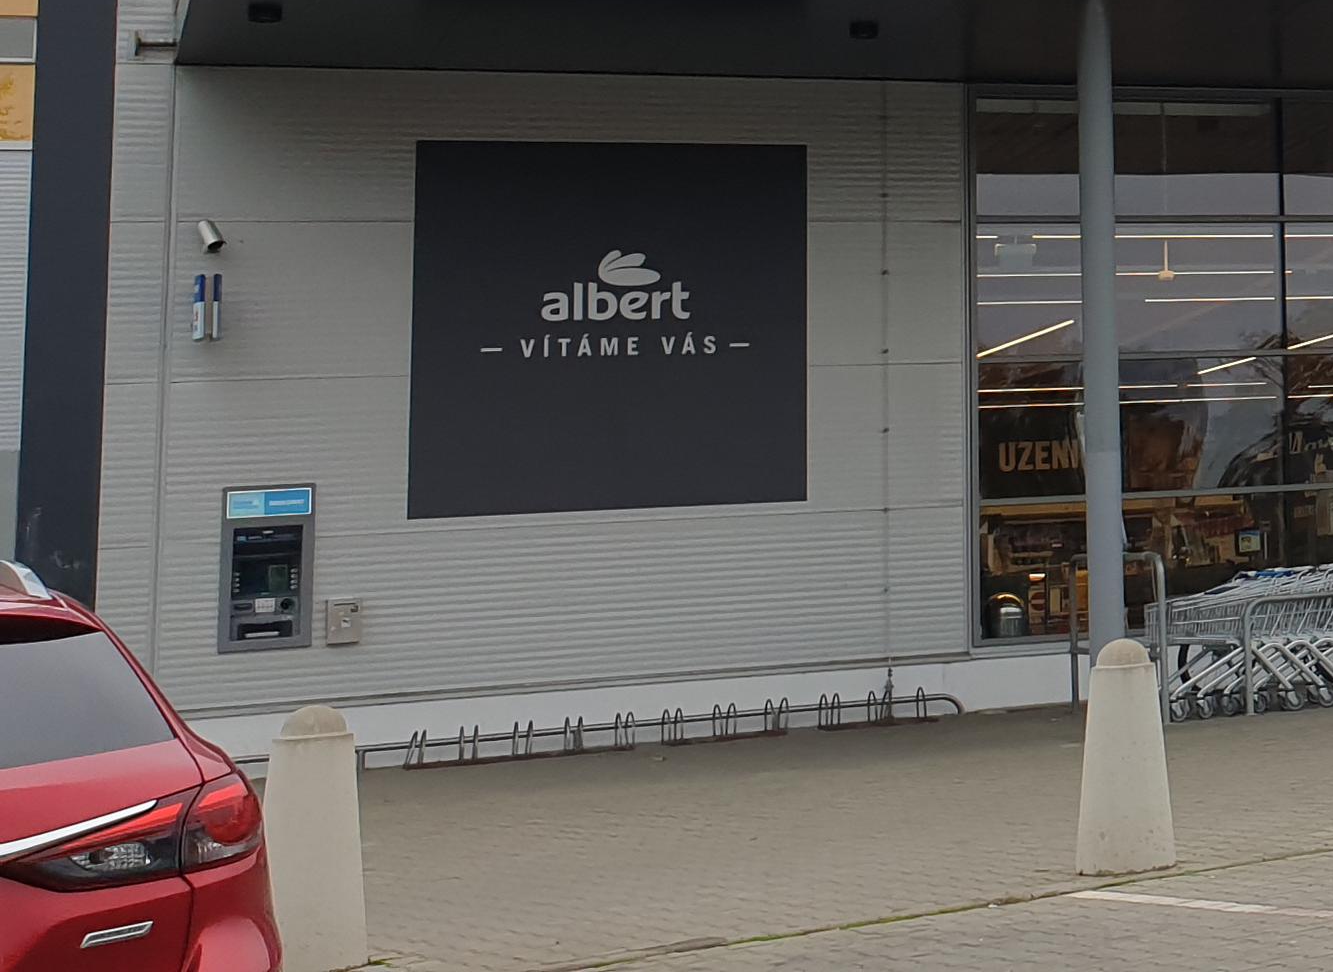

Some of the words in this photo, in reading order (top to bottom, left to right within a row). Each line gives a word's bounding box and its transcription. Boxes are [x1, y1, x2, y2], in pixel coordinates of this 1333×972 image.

[541, 281, 690, 321] albert
[520, 333, 639, 358] VÍTÁME
[661, 332, 717, 355] VÁS
